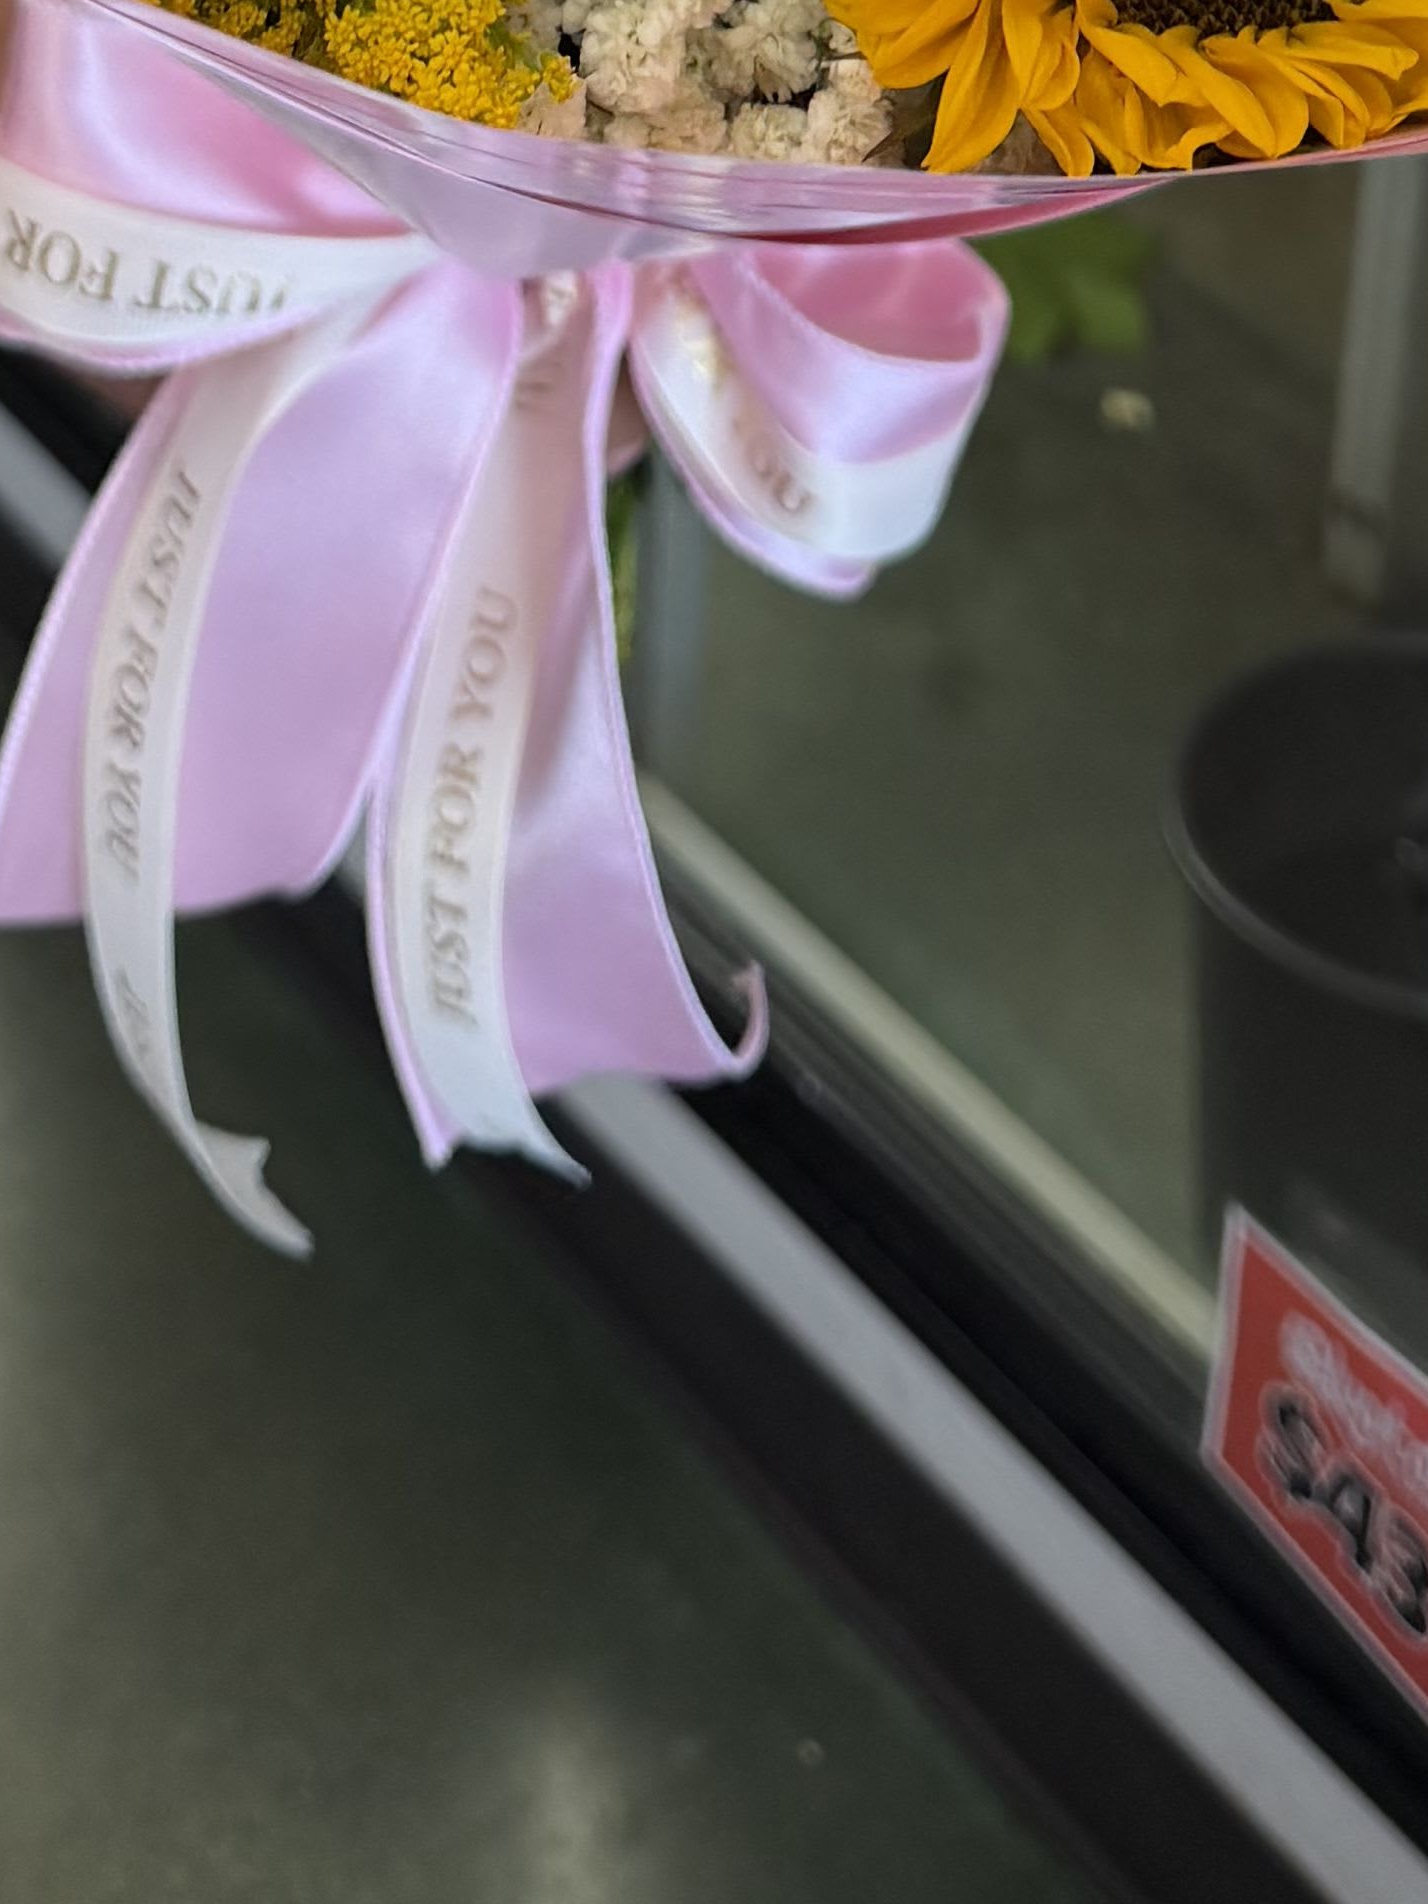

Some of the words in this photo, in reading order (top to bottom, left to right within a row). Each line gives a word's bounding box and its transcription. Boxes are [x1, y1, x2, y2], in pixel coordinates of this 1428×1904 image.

[4, 208, 120, 302] FOR
[132, 256, 294, 314] JUST
[136, 469, 202, 631] JUST
[107, 623, 160, 754] FOR
[448, 586, 519, 722] YOU
[102, 758, 143, 886] YOU
[429, 740, 483, 880] FOR
[425, 880, 480, 1033] JUST
